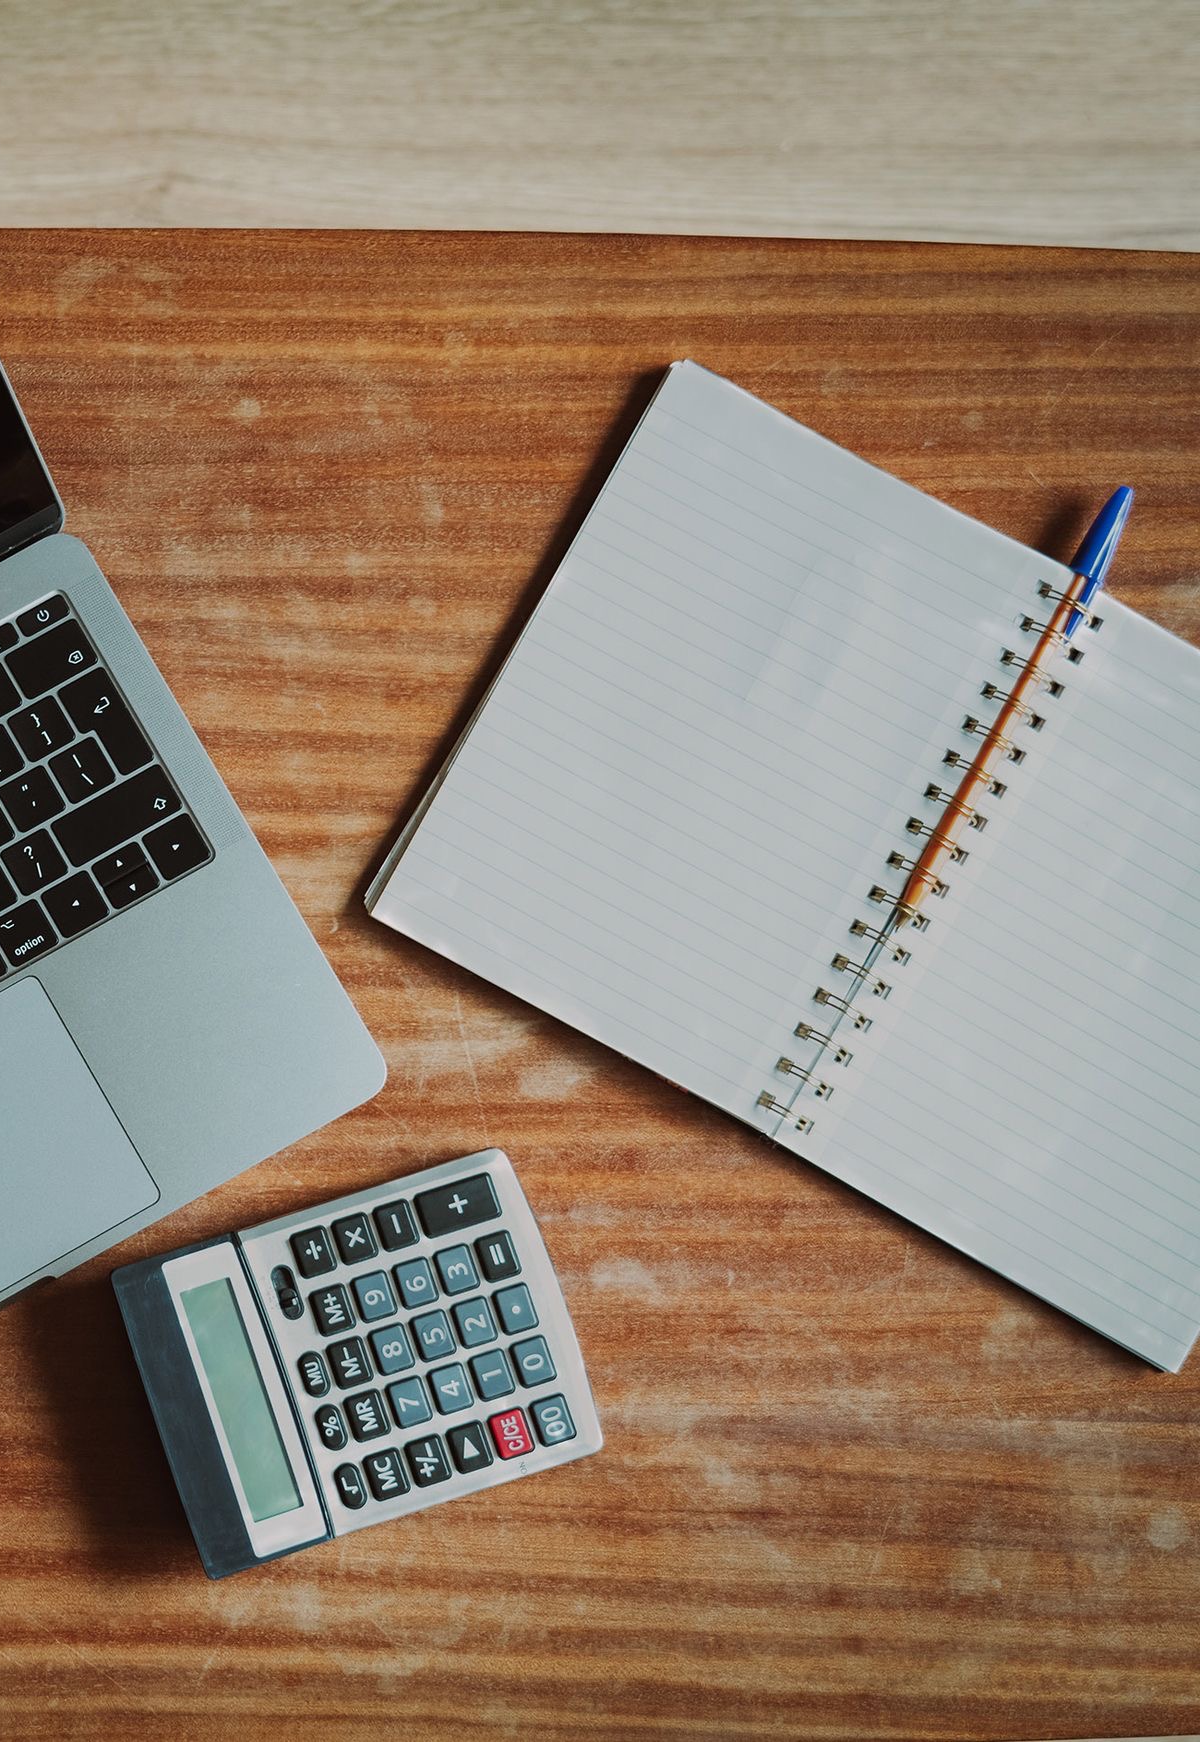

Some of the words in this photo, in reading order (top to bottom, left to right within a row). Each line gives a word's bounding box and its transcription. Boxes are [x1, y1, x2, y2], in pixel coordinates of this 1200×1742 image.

[31, 714, 40, 727] }
[42, 731, 51, 745] ]
[24, 846, 33, 859] ?
[14, 935, 45, 957] option
[449, 1194, 467, 1213] +
[345, 1226, 365, 1247] ×
[306, 1241, 321, 1259] ÷
[490, 1244, 505, 1265] =
[448, 1262, 468, 1279] 3
[406, 1275, 426, 1291] 6
[365, 1289, 386, 1305] 9
[325, 1293, 345, 1324] M+
[465, 1314, 487, 1331] 2
[423, 1327, 445, 1344] 5
[383, 1340, 402, 1358] 8
[523, 1354, 543, 1370] 0
[307, 1360, 324, 1385] MU
[482, 1368, 501, 1381] 1
[441, 1380, 459, 1396] 4
[399, 1396, 420, 1411] 7
[355, 1399, 378, 1431] MR
[541, 1406, 565, 1436] 00
[323, 1415, 340, 1436] %
[501, 1416, 525, 1449] C/CE
[373, 1457, 398, 1490] MC
